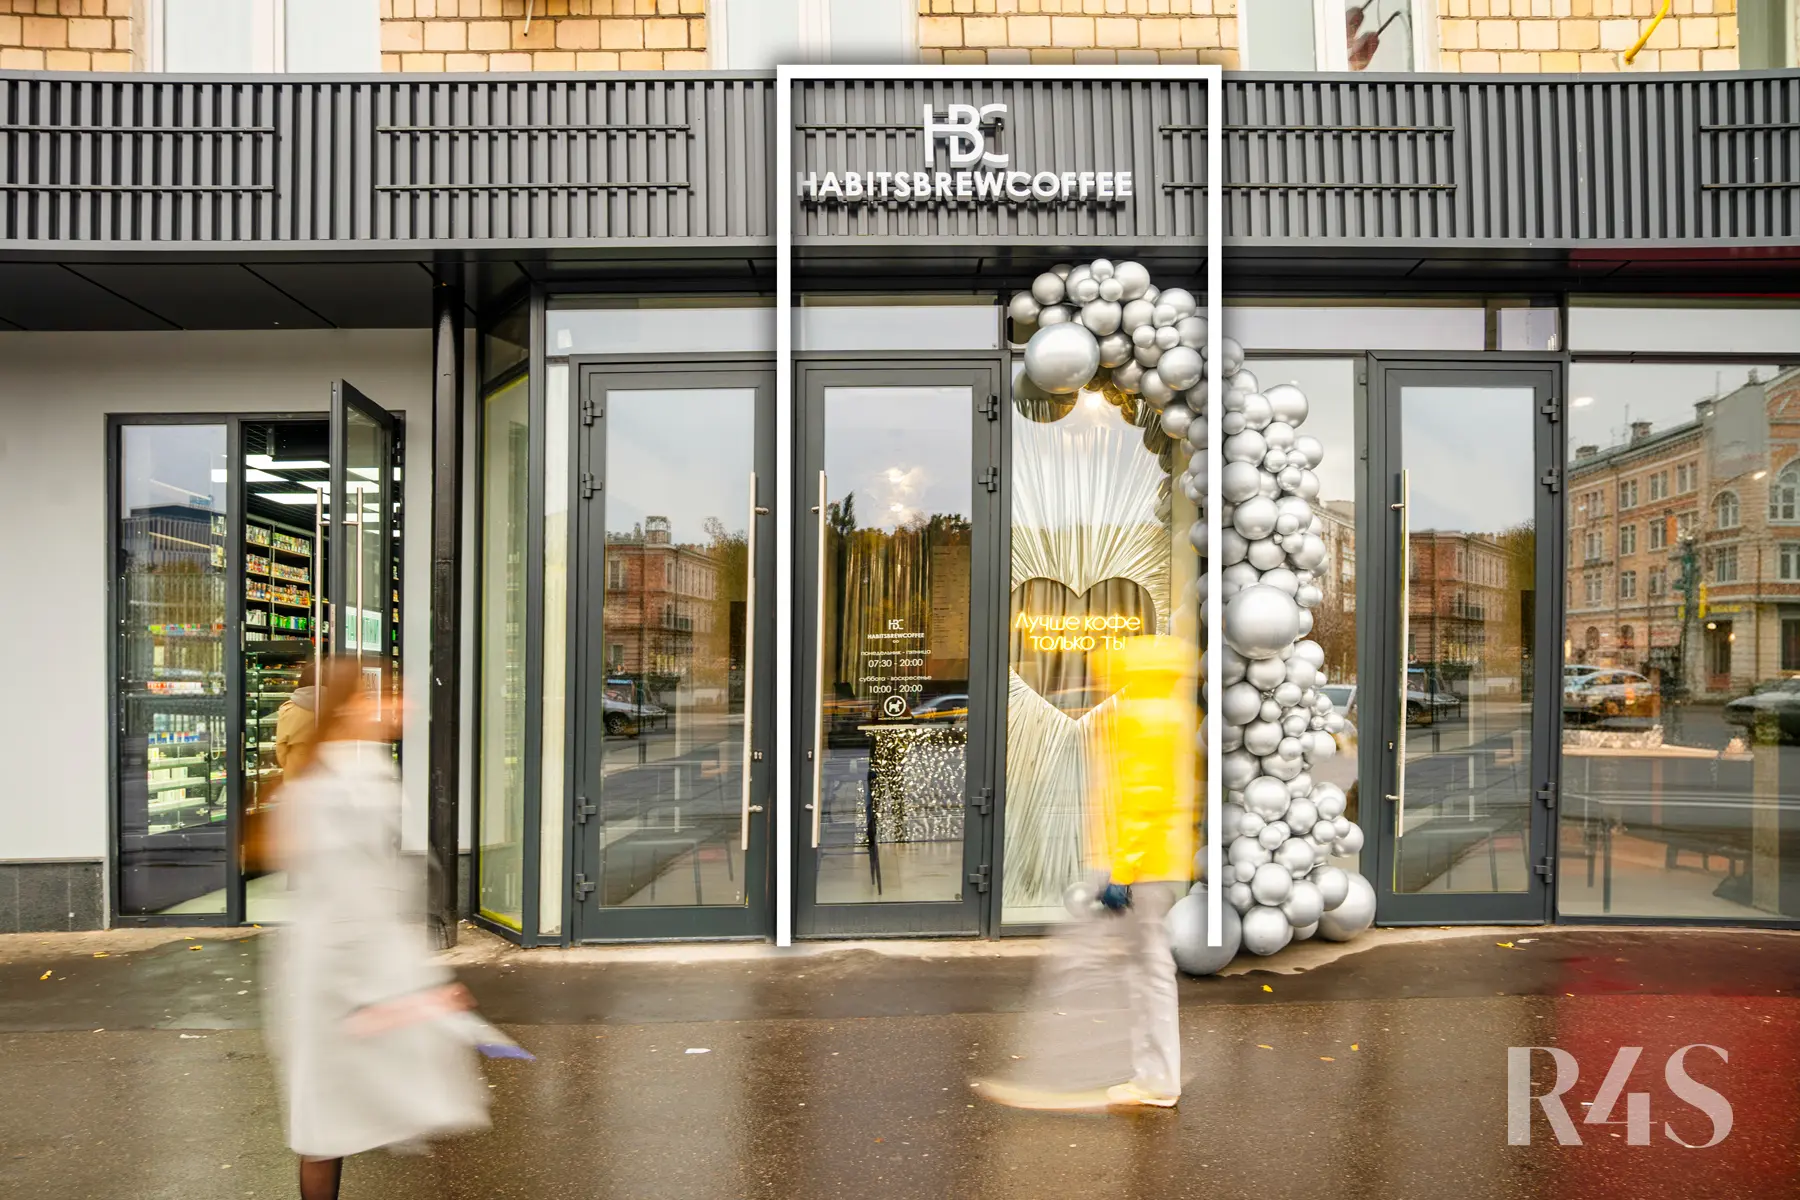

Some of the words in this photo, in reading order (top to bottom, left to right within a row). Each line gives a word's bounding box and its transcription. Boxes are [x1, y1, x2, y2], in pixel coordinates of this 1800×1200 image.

[797, 171, 1133, 201] HABITSBREWCOFFEE
[1015, 611, 1081, 633] Лучше
[1084, 613, 1141, 632] кофе
[868, 659, 892, 668] 07:30
[899, 659, 923, 667] 20:00
[869, 685, 892, 693] 10:00
[899, 684, 923, 693] 20:00
